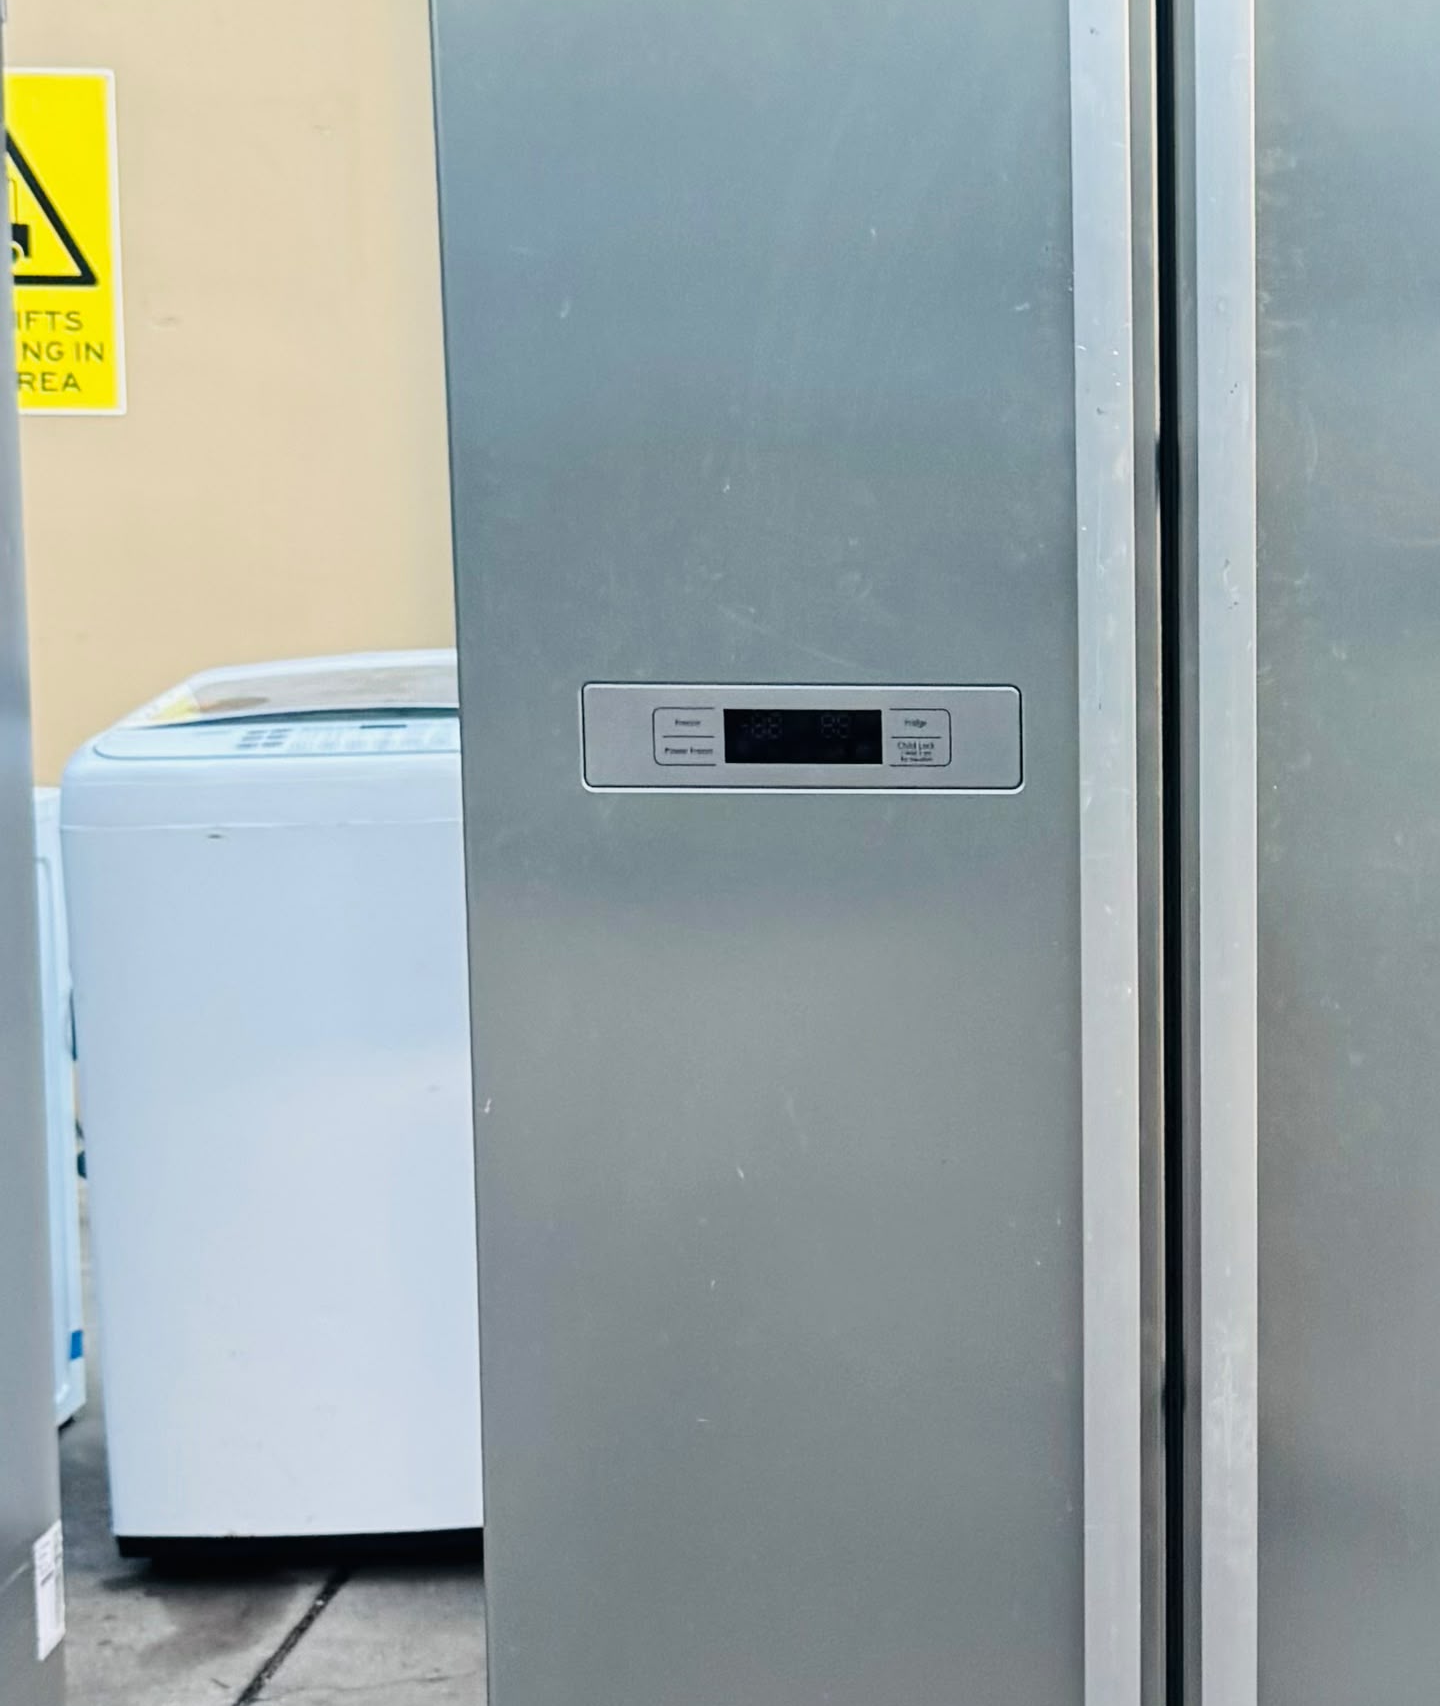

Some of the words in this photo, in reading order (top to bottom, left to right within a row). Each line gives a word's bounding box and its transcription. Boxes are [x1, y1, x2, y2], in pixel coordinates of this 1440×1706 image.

[16, 310, 83, 331] IFTS
[21, 340, 64, 361] NG
[75, 341, 104, 361] IN
[17, 371, 82, 392] REA
